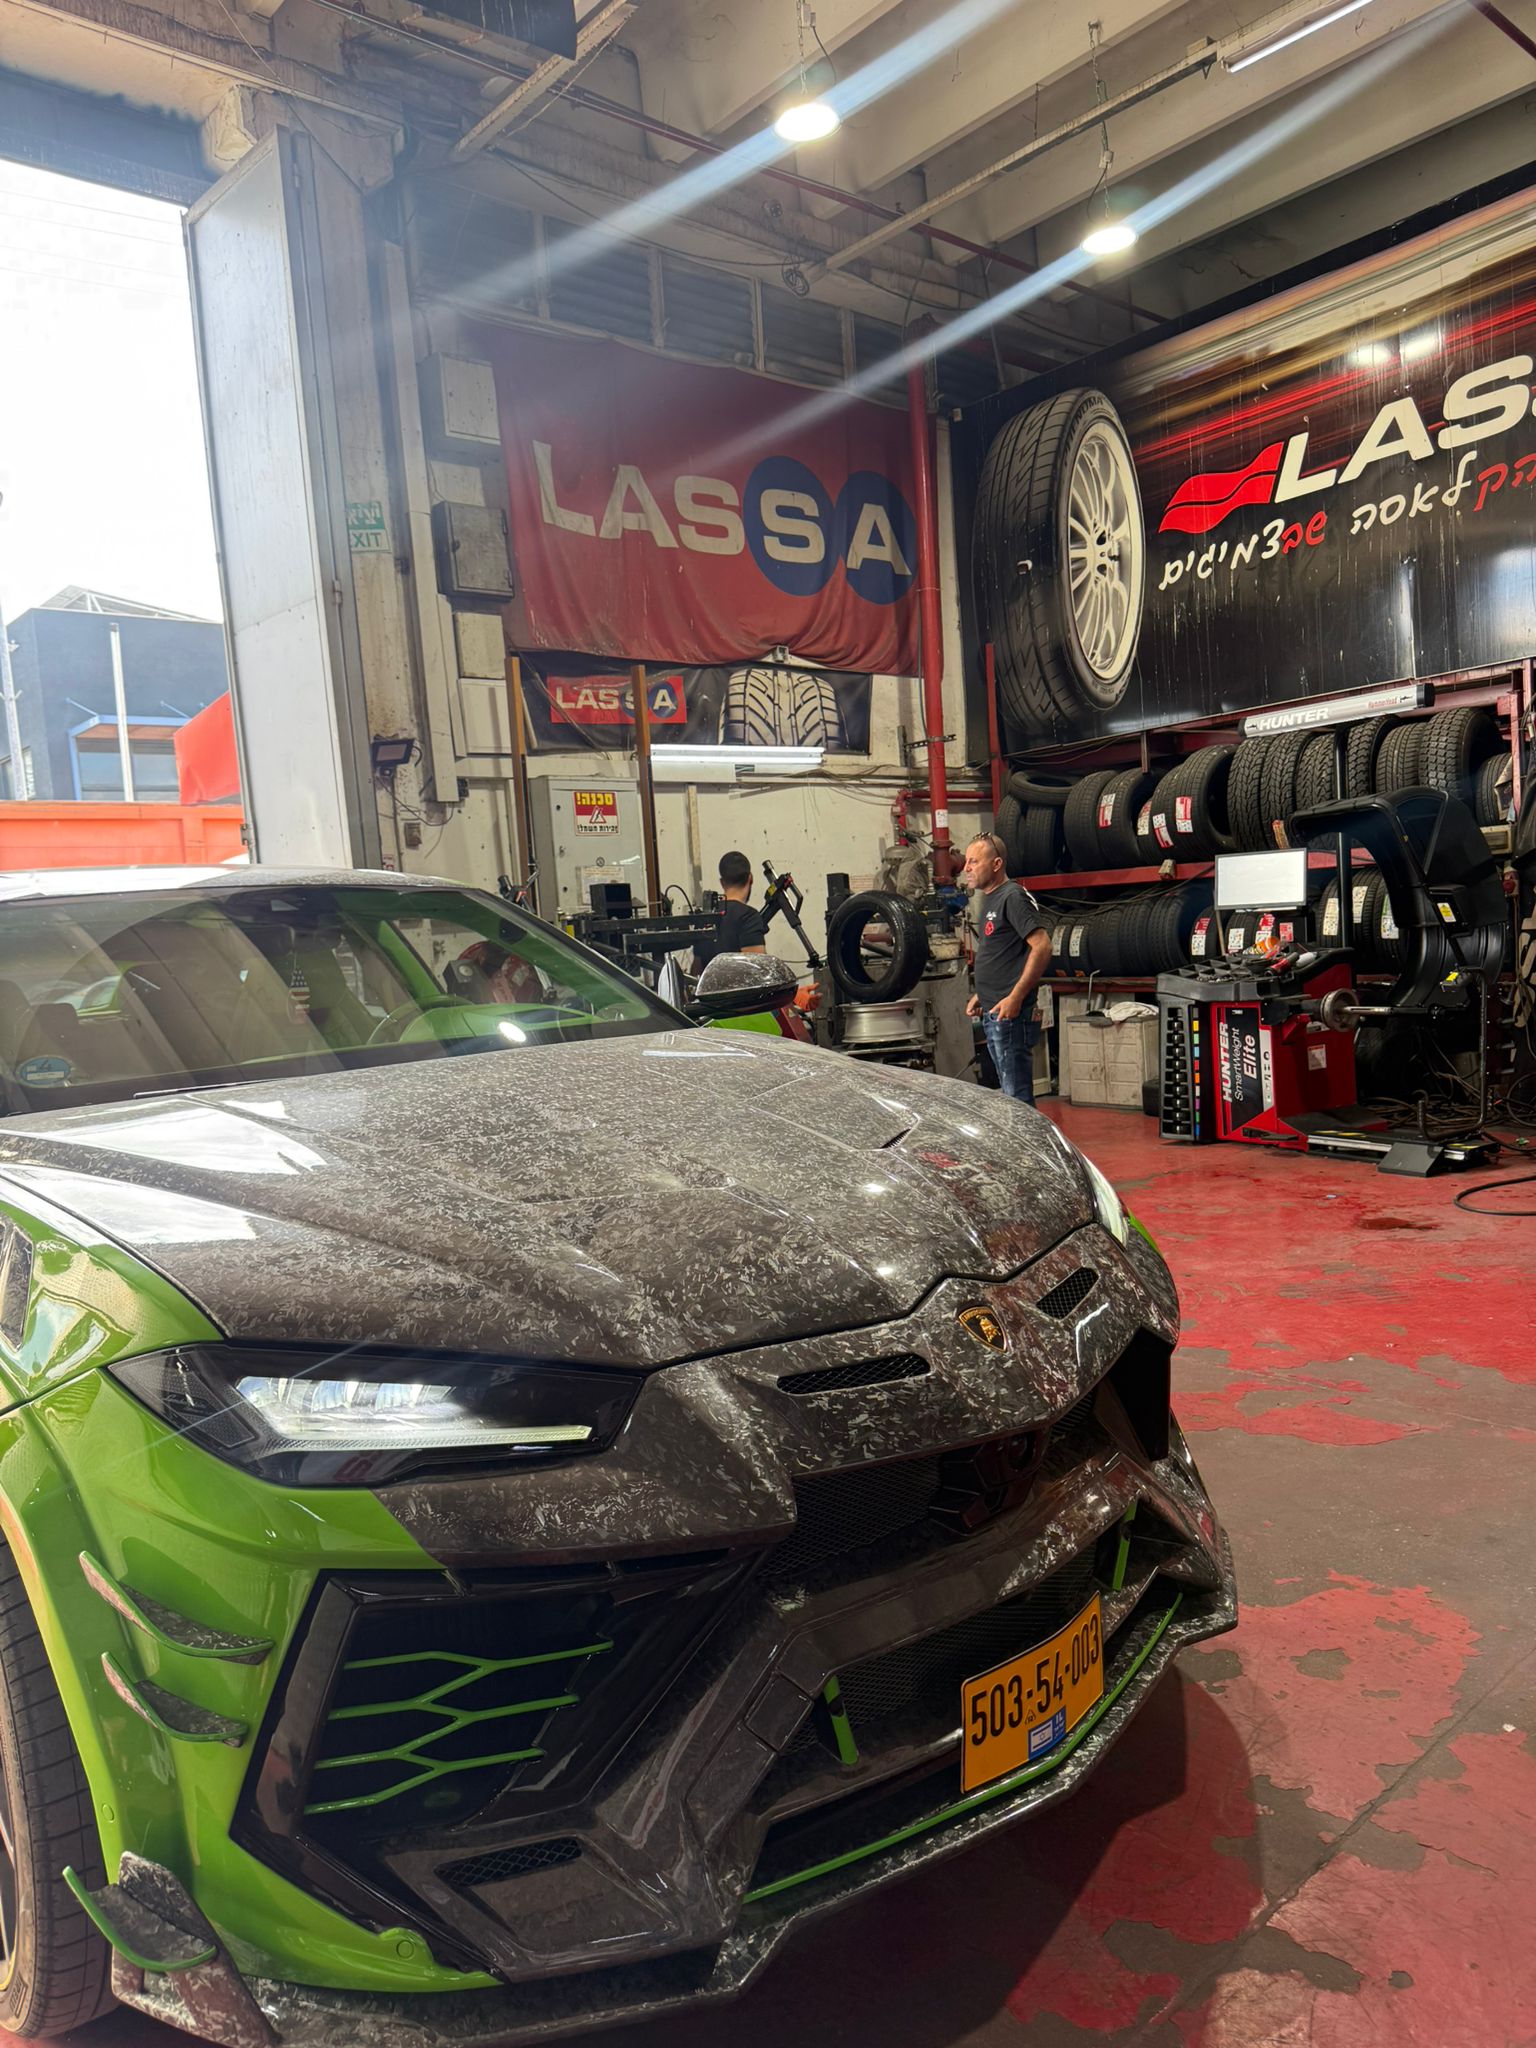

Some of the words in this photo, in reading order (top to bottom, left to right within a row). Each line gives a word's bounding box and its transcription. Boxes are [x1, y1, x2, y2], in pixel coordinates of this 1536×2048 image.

[1274, 355, 1536, 503] LAS
[351, 532, 382, 548] XIT
[532, 440, 912, 576] LASSA
[1258, 707, 1329, 732] HUNTER
[576, 792, 613, 805] סכנה!
[1219, 1021, 1233, 1103] HUNTER
[1232, 1027, 1244, 1102] SmartWeight
[1242, 1034, 1257, 1080] Elite
[971, 1613, 1099, 1746] 503-54-003
